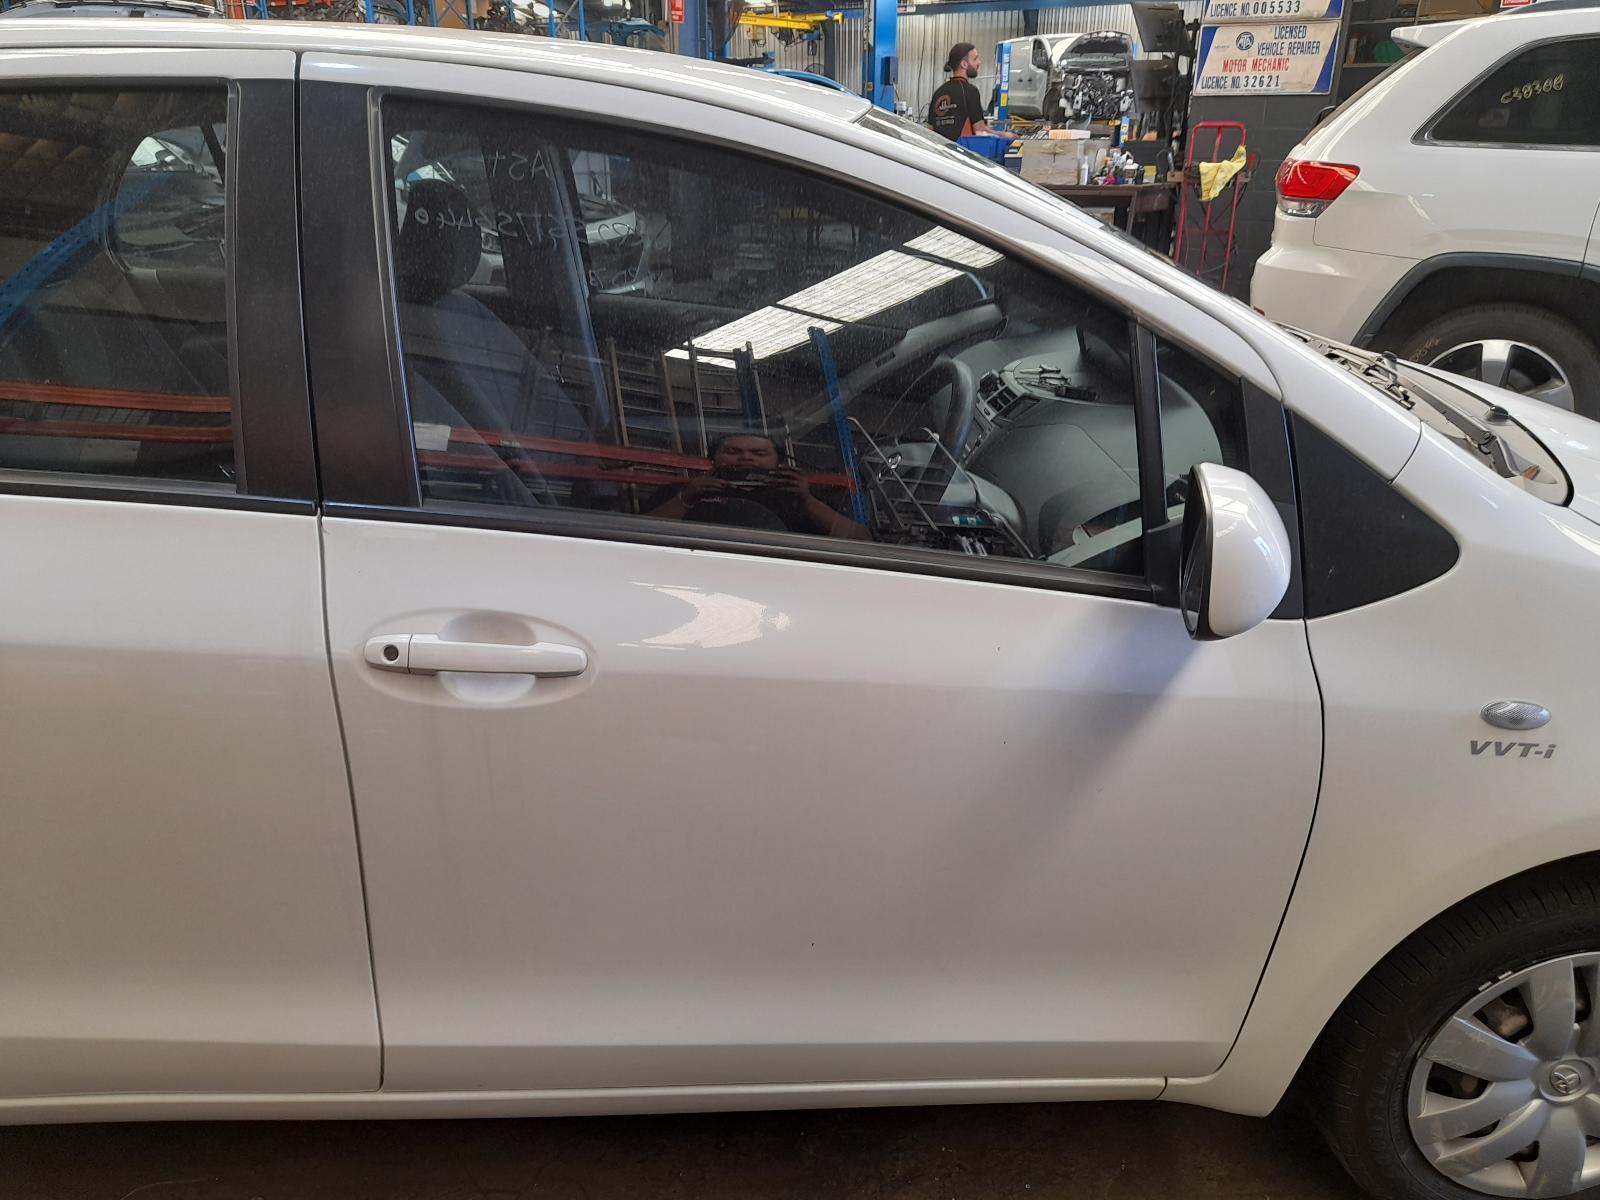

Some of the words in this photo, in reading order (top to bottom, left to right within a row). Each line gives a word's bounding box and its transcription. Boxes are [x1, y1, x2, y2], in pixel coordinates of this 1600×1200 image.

[1210, 3, 1237, 17] LICENCE
[1253, 0, 1300, 15] 005533
[1274, 25, 1307, 40] LICENSED
[1257, 42, 1284, 56] VEHICLE
[1287, 40, 1321, 55] REPAIRER
[1222, 59, 1247, 73] MOTOR
[1251, 58, 1290, 72] MECHANIC
[1201, 75, 1228, 89] LICENCE
[1243, 75, 1280, 88] 32621
[1470, 740, 1557, 759] VVT-i
